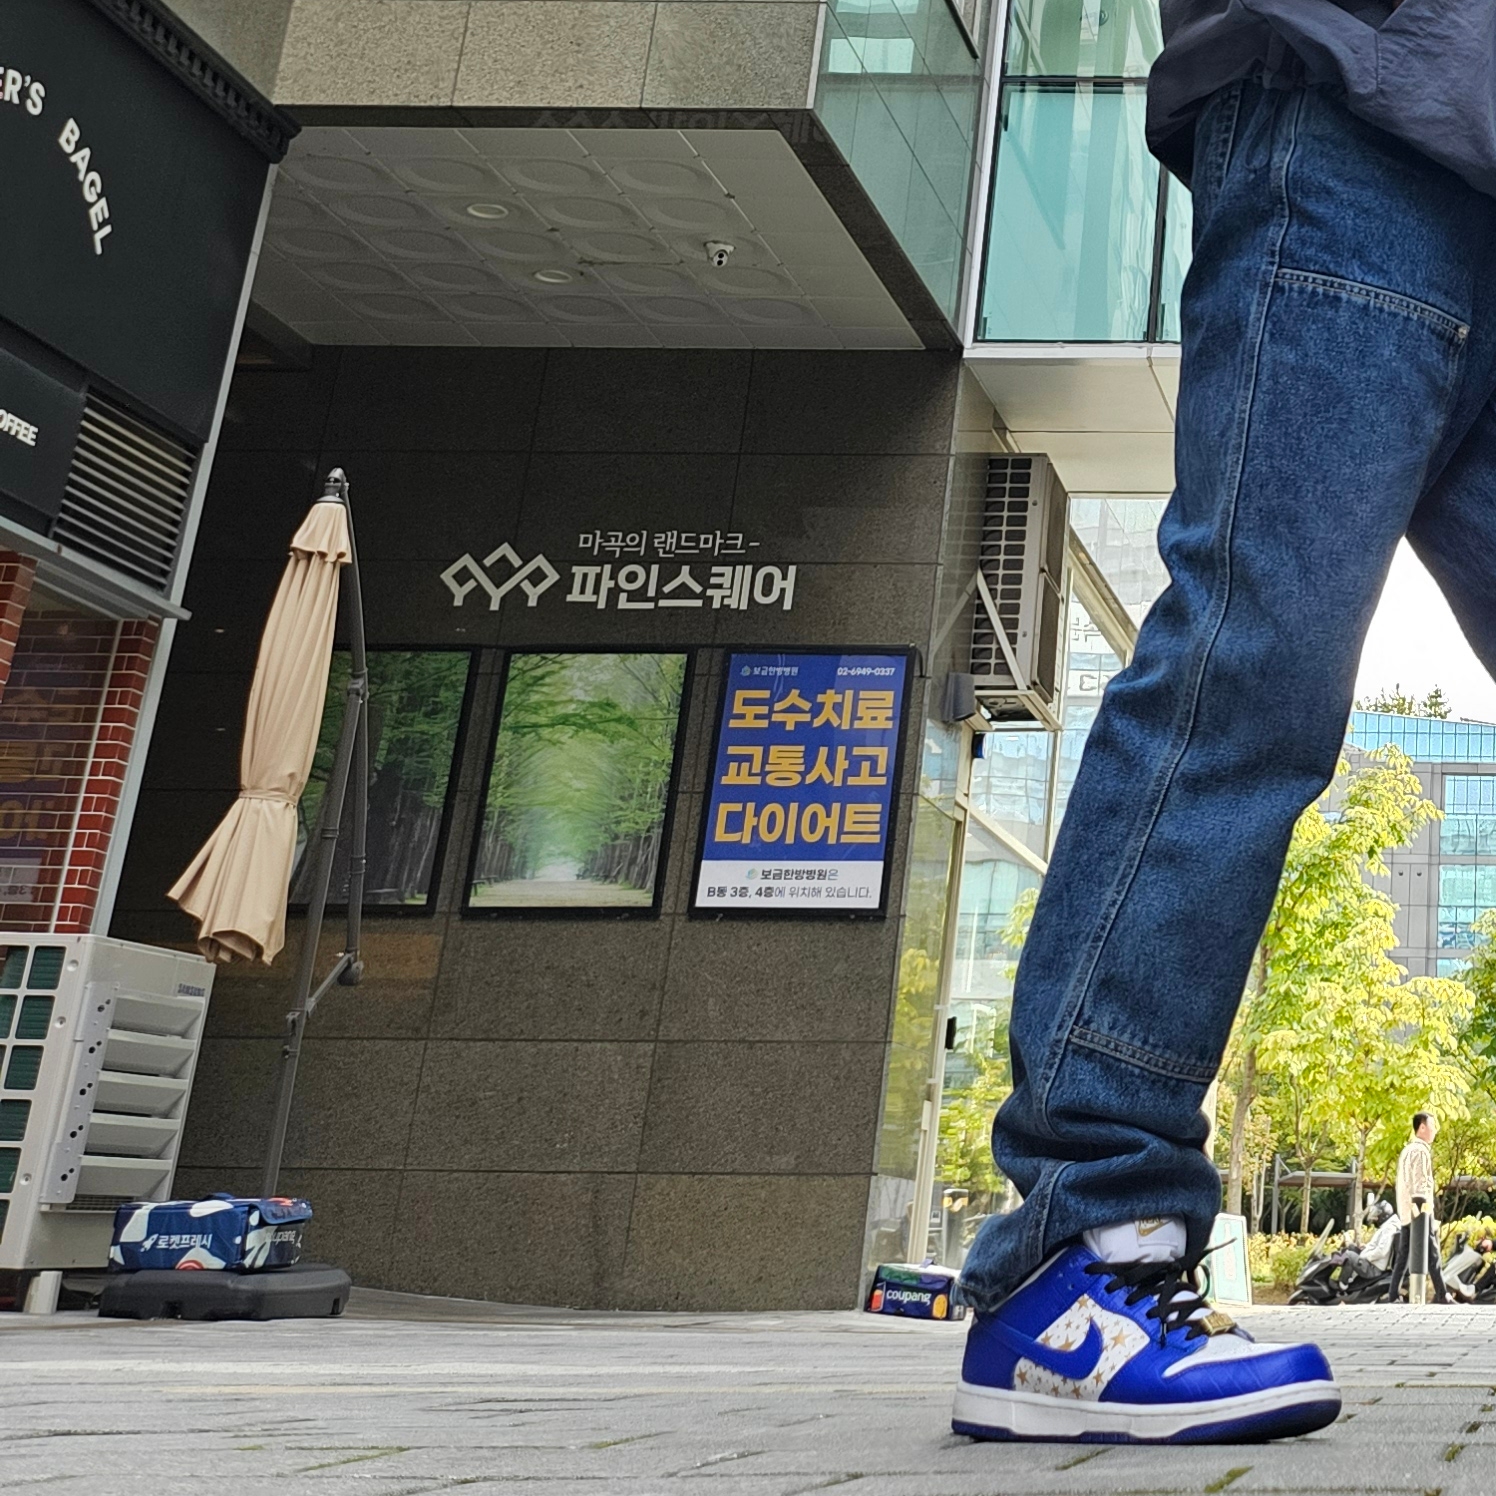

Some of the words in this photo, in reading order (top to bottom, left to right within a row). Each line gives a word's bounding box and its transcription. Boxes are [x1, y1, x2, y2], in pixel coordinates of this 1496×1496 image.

[58, 117, 112, 255] BAGEL
[578, 530, 646, 557] 마곡의
[566, 564, 797, 610] 파인스퀘어
[752, 666, 799, 676] 보금한방병원
[728, 689, 895, 730] 도수치료
[720, 745, 888, 786] 교통사고
[714, 802, 882, 844] 다이어트
[760, 868, 838, 881] 보금한방병원은
[707, 886, 727, 898] B동
[755, 886, 785, 898] 4층에
[788, 886, 821, 899] 위치해
[825, 886, 872, 899] 있습니다.
[156, 1233, 213, 1249] 로켓프레시
[886, 1289, 932, 1306] coupang
